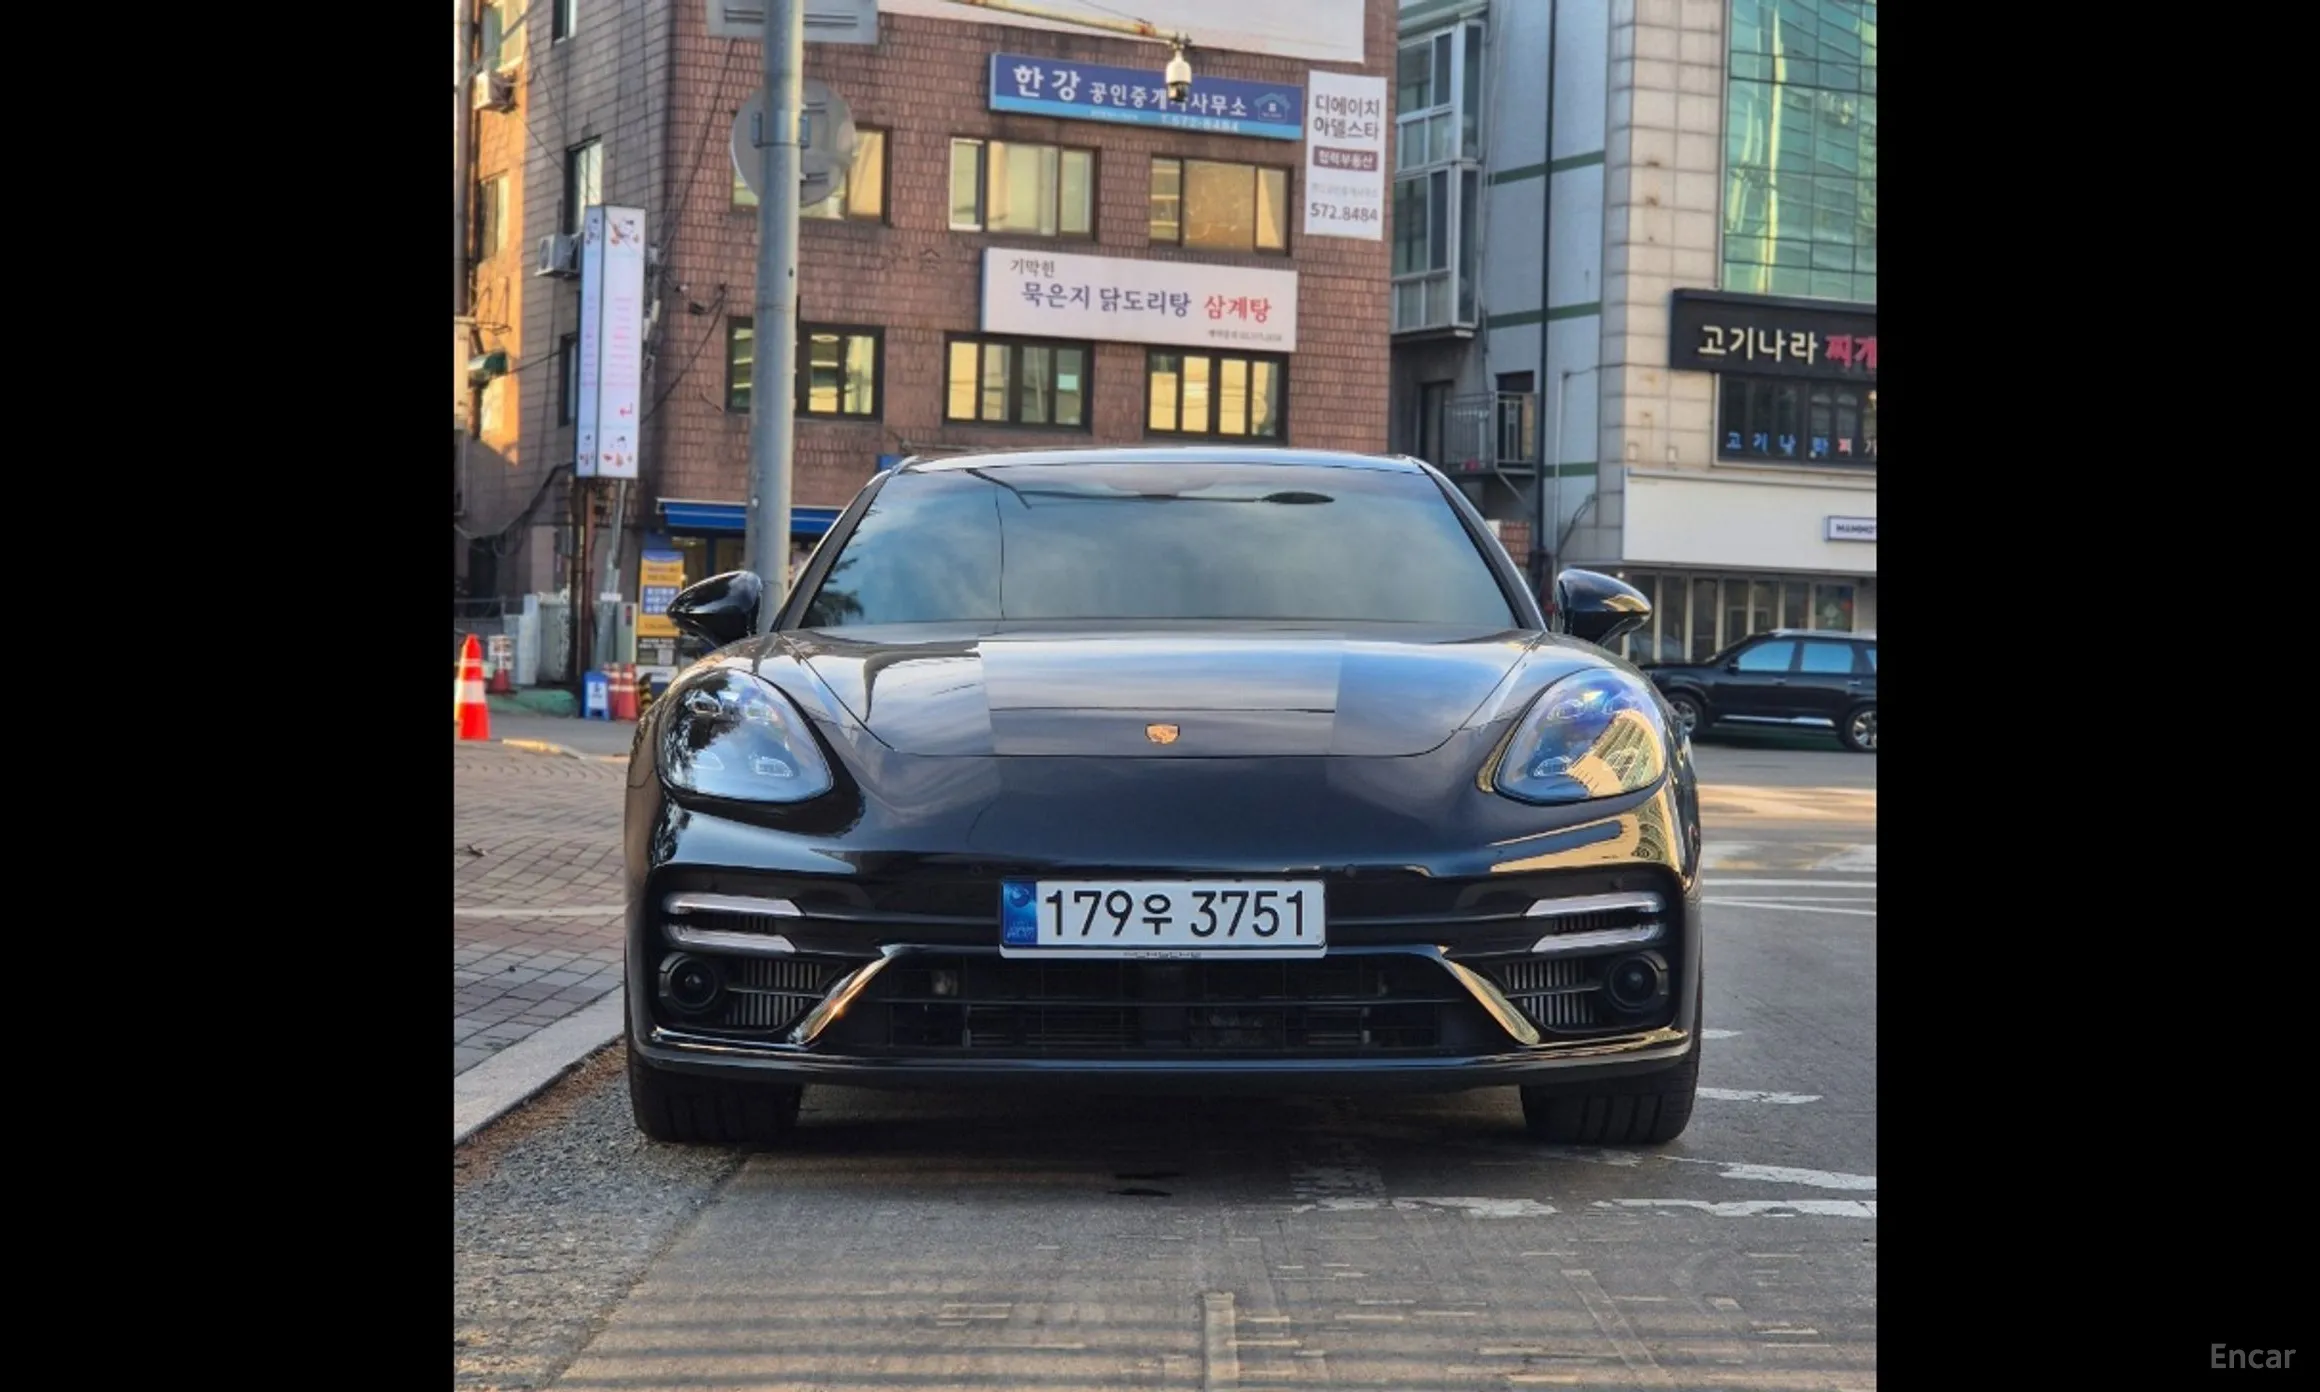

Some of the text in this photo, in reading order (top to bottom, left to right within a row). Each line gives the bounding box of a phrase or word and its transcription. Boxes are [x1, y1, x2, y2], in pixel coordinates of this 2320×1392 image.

[1012, 64, 1082, 101] 한강
[1315, 94, 1380, 118] 디에이치
[1313, 117, 1379, 140] 아델스타
[1310, 202, 1379, 222] 572.8484
[1010, 258, 1055, 278] 기막힌
[1022, 281, 1272, 324] 묵은지 닭도리탕 삼계탕
[1697, 324, 1819, 365] 고기나라
[1045, 889, 1173, 938] 179우
[1190, 889, 1304, 938] 3751
